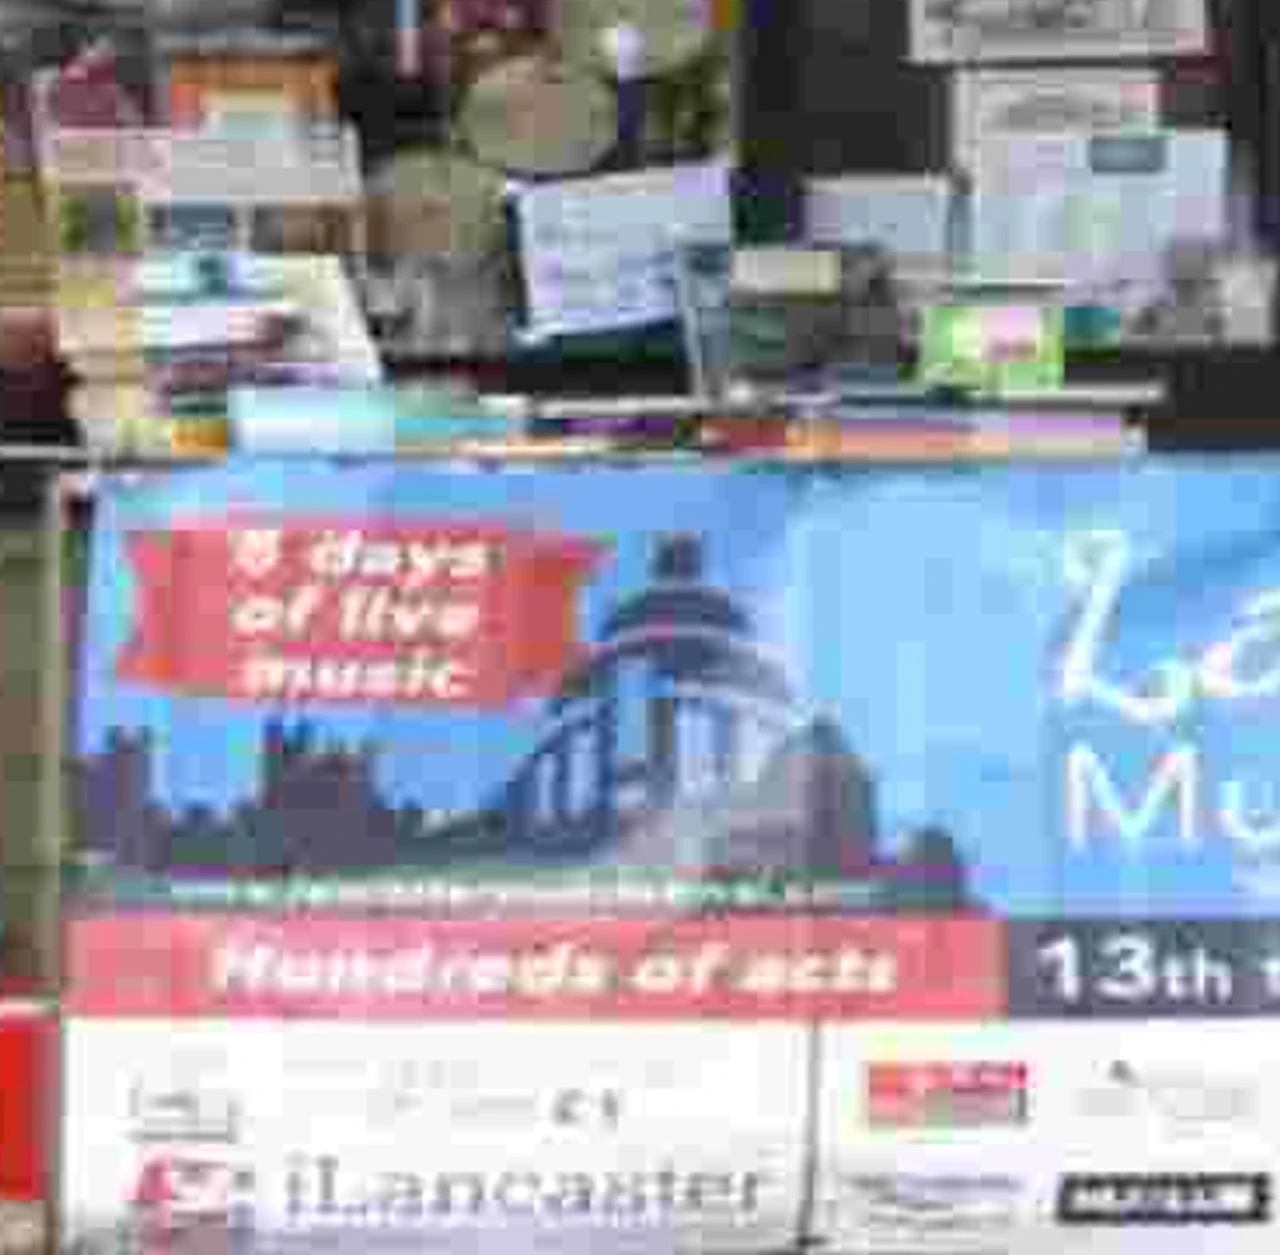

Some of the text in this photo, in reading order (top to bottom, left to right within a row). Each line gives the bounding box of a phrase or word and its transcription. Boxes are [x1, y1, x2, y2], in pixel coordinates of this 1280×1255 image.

[310, 530, 490, 587] days
[228, 584, 480, 638] of live
[242, 648, 472, 697] music
[217, 940, 898, 994] Hundreds of acts
[1038, 934, 1233, 1000] 13th
[283, 1148, 764, 1228] iLancaster
